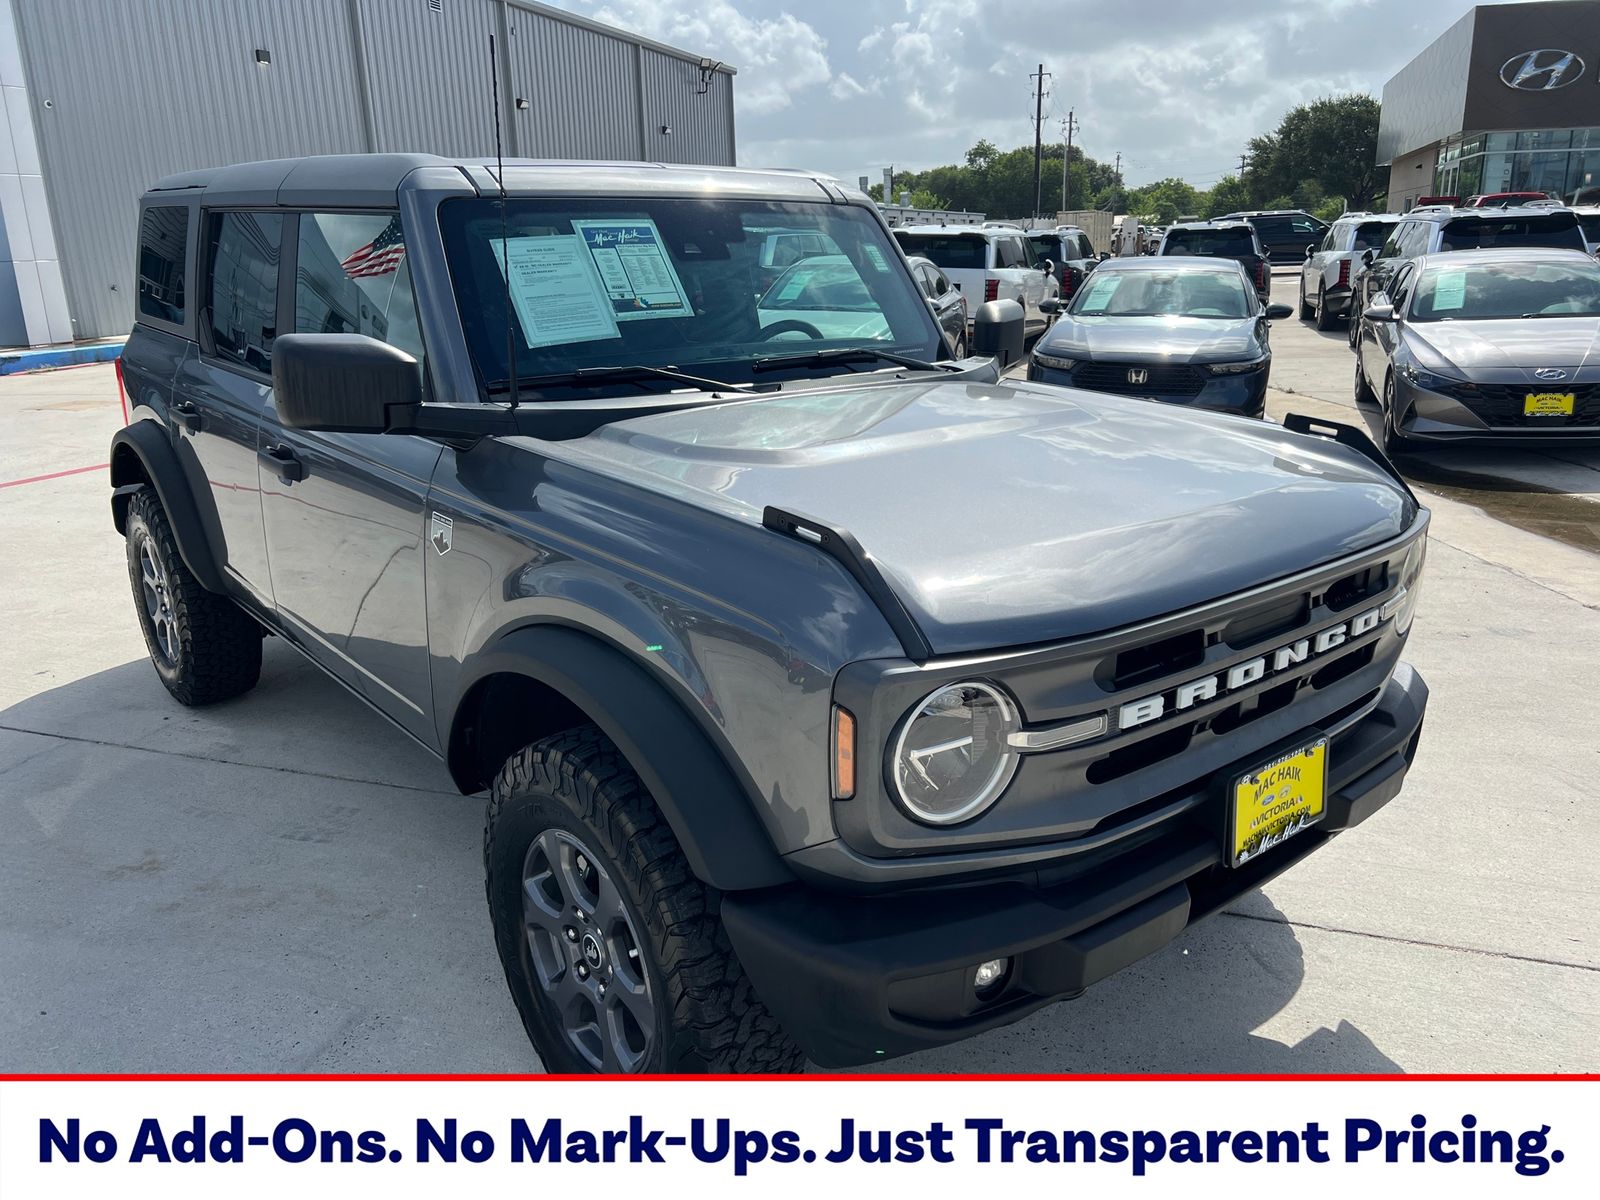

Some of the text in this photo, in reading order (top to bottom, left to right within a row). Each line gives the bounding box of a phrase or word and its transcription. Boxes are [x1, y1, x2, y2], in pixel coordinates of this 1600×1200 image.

[595, 233, 617, 246] Mac
[618, 229, 639, 244] Haik
[1119, 608, 1379, 729] BRONCO
[1254, 771, 1277, 805] MAC
[1278, 766, 1301, 782] HAIK
[1256, 798, 1296, 826] VICTORIA
[1258, 834, 1281, 854] Mac
